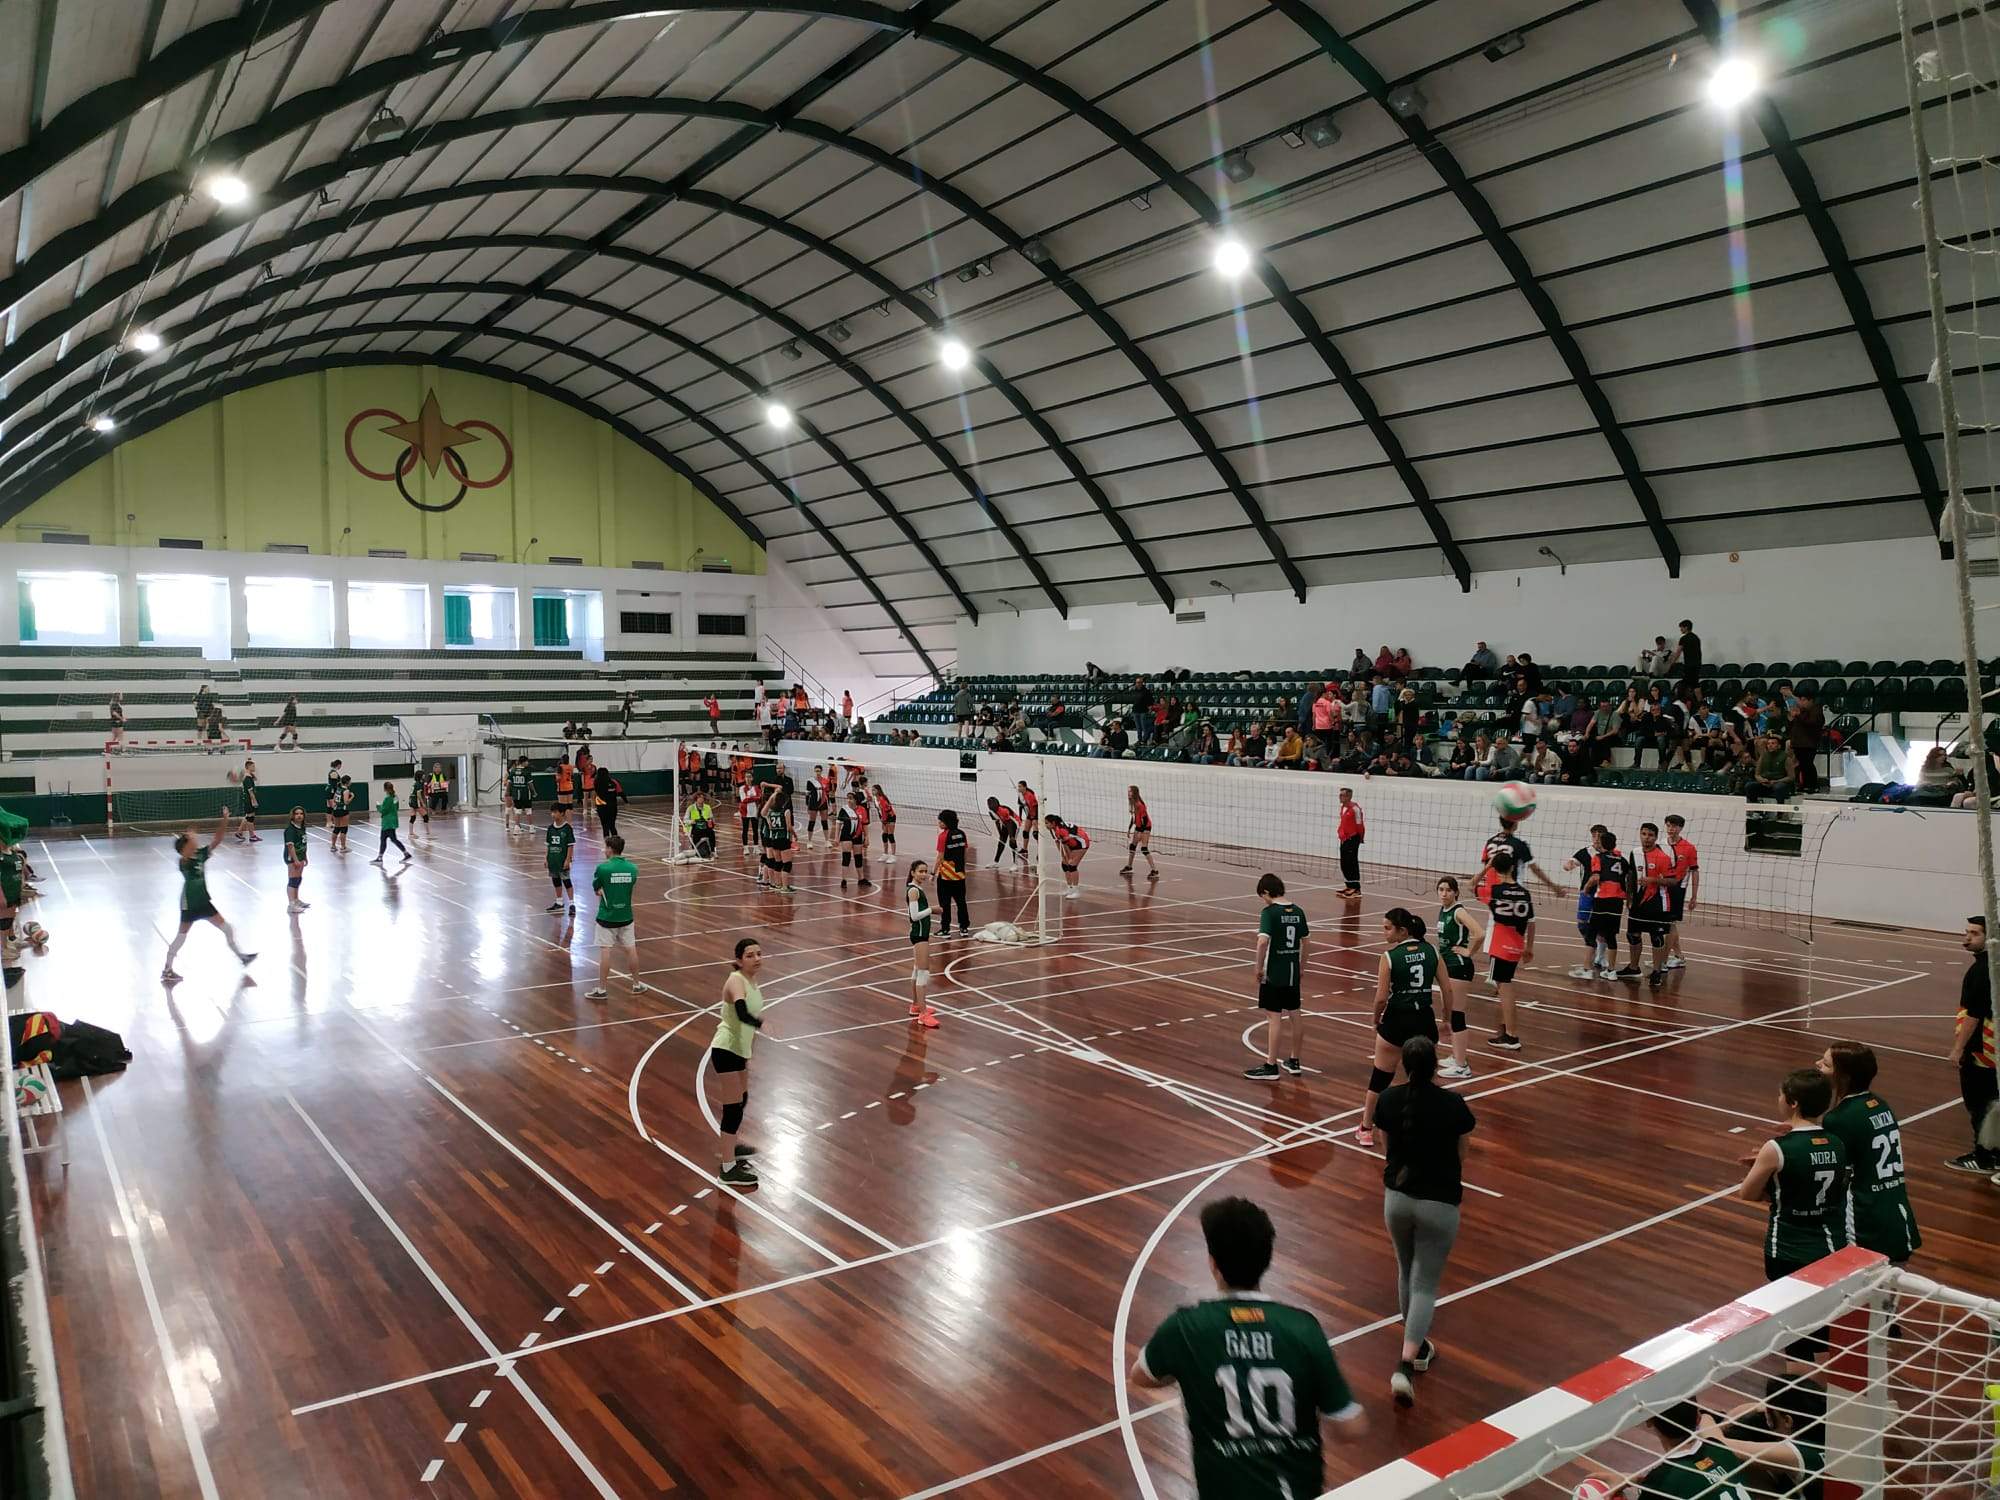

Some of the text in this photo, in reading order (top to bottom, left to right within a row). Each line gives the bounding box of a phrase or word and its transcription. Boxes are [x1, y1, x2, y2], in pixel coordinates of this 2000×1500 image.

[1611, 862, 1623, 875] 4
[1495, 900, 1529, 917] 20
[1286, 925, 1296, 948] 9
[1409, 964, 1424, 988] 3
[1810, 1151, 1837, 1165] NORA
[1872, 1129, 1904, 1179] 23
[1814, 1170, 1835, 1206] 7
[1225, 1329, 1275, 1360] GABI
[1215, 1364, 1297, 1439] 10
